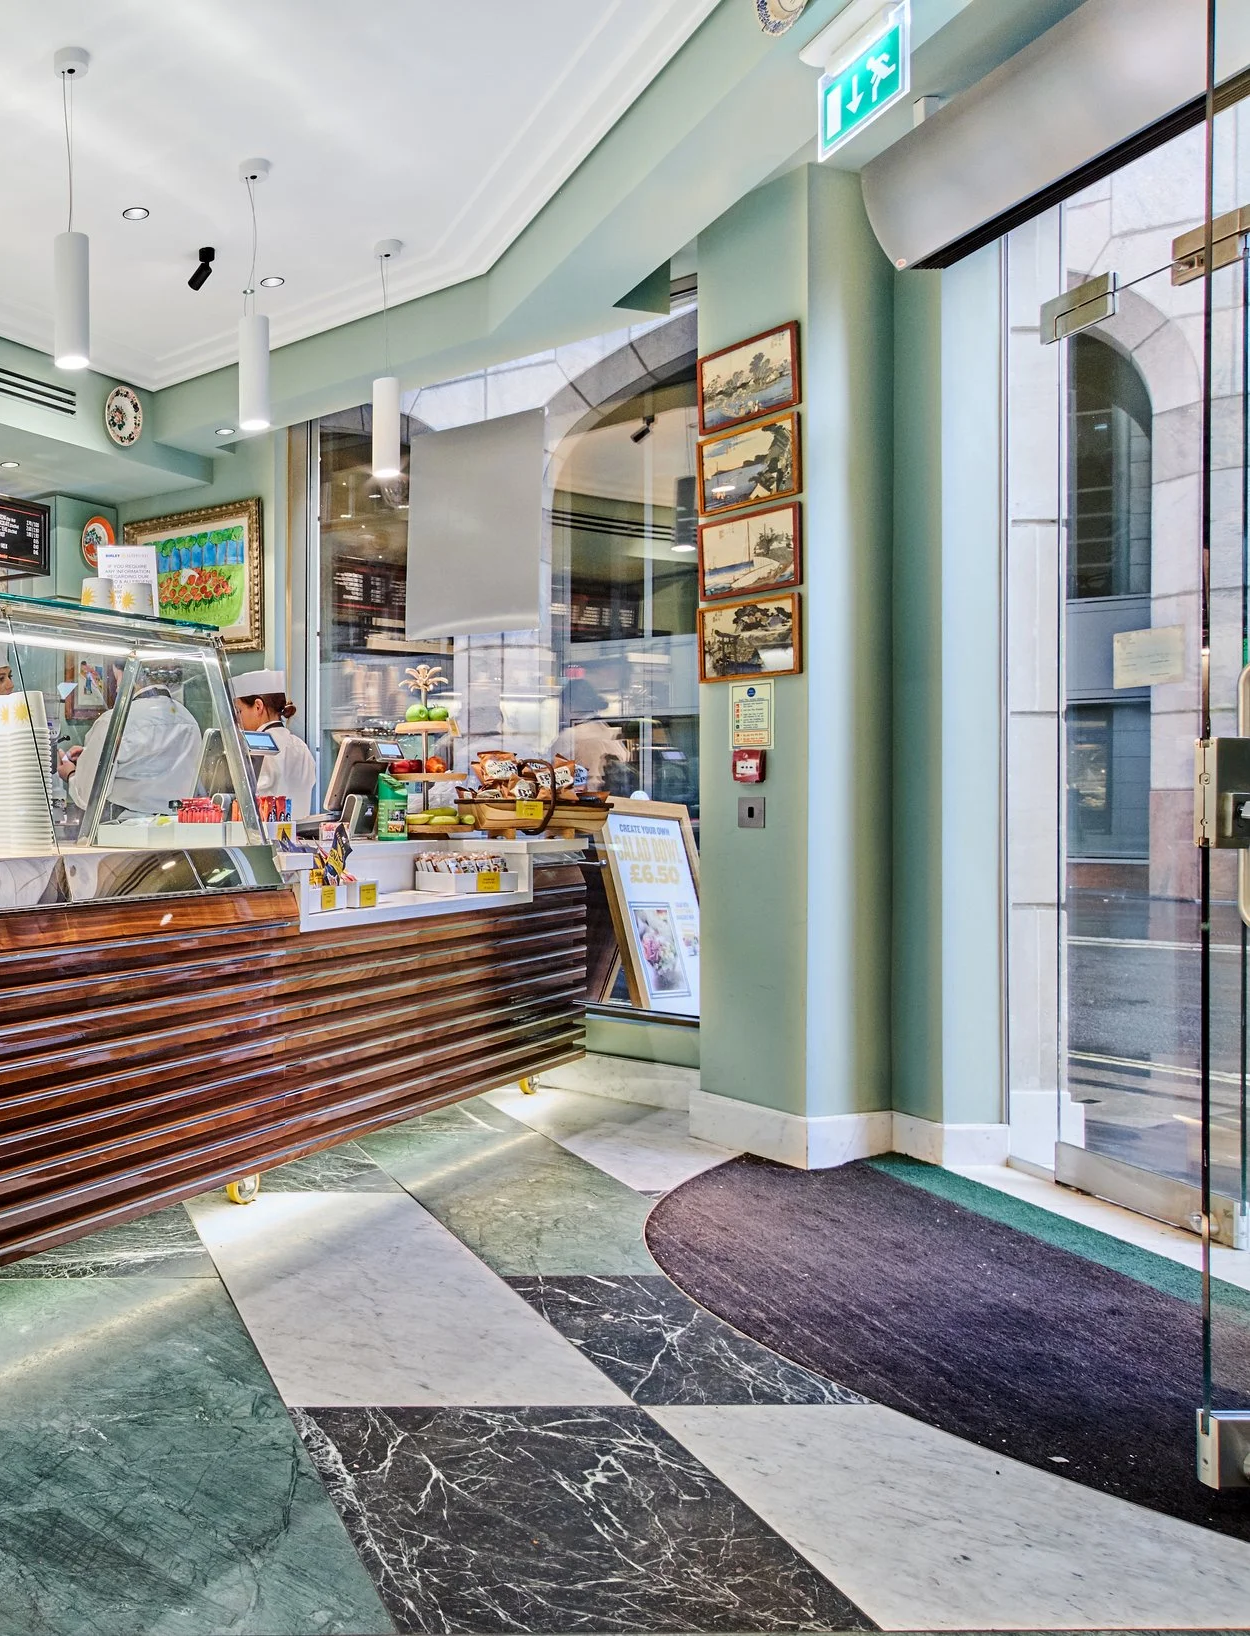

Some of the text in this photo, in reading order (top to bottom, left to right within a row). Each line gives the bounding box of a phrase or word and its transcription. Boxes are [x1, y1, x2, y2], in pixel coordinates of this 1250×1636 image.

[619, 824, 670, 836] CREATE YOUR OWN
[615, 834, 682, 864] SALAD BOWL
[630, 864, 680, 884] £6.50
